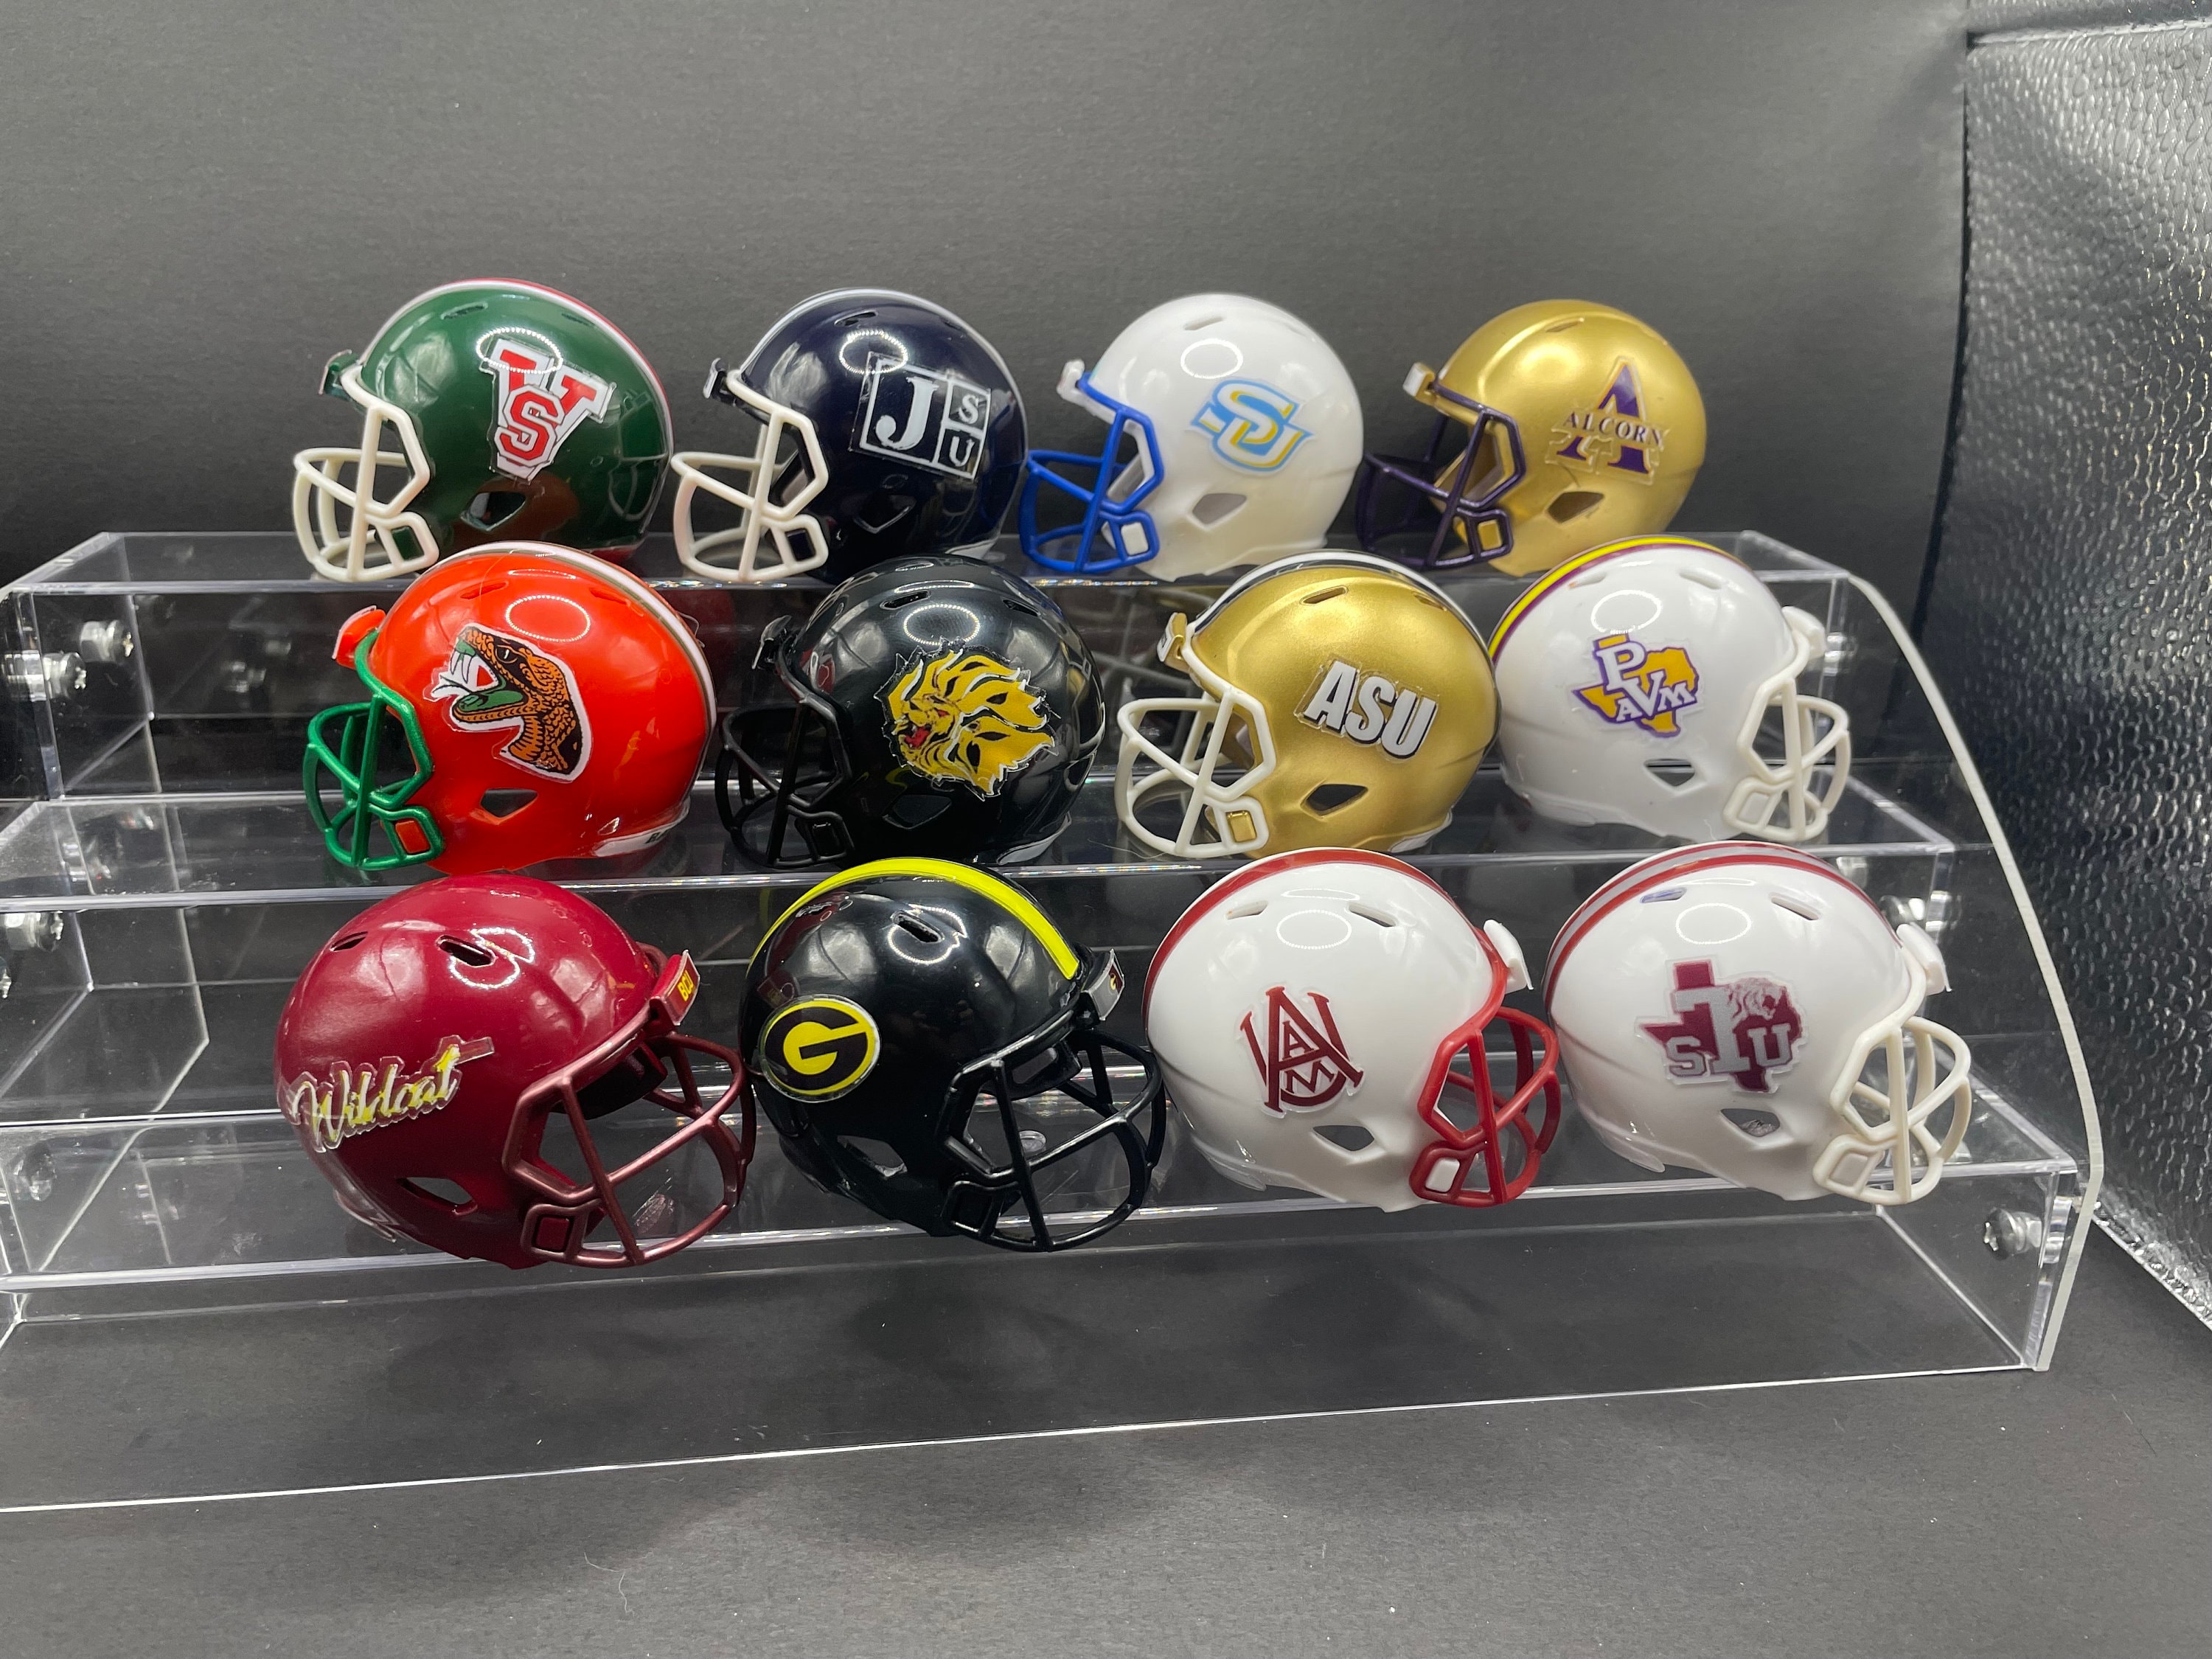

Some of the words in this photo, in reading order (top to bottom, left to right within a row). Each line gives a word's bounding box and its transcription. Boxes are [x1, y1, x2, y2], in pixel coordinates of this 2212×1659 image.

[1562, 411, 1671, 451] ALCORN
[1303, 660, 1437, 759] ASU
[764, 1005, 869, 1091] G
[292, 1043, 461, 1147] Wildcat
